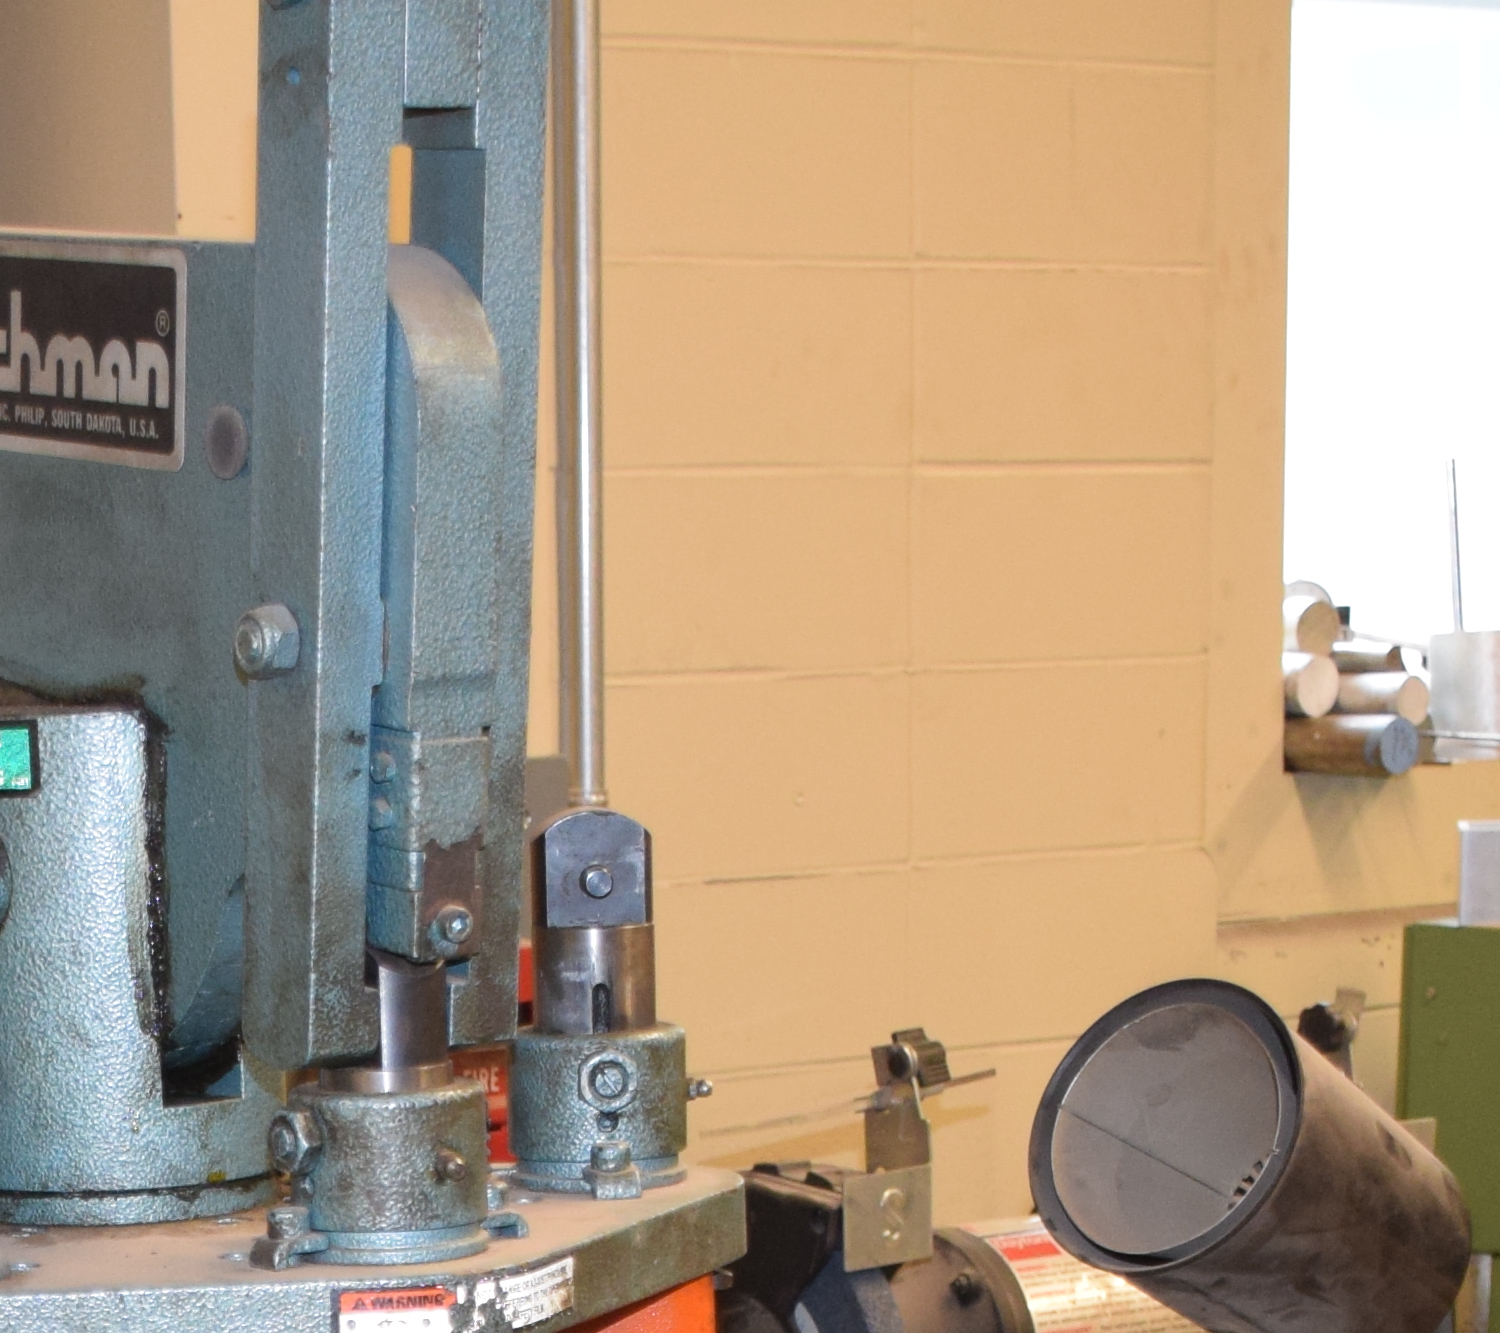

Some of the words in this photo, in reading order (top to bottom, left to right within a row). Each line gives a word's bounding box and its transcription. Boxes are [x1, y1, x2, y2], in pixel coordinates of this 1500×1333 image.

[14, 405, 48, 428] PHILIP,
[51, 409, 82, 429] SOUTH
[85, 413, 125, 438] DAKOTA,
[128, 418, 159, 440] U.S.A.
[371, 1293, 446, 1311] WARNING
